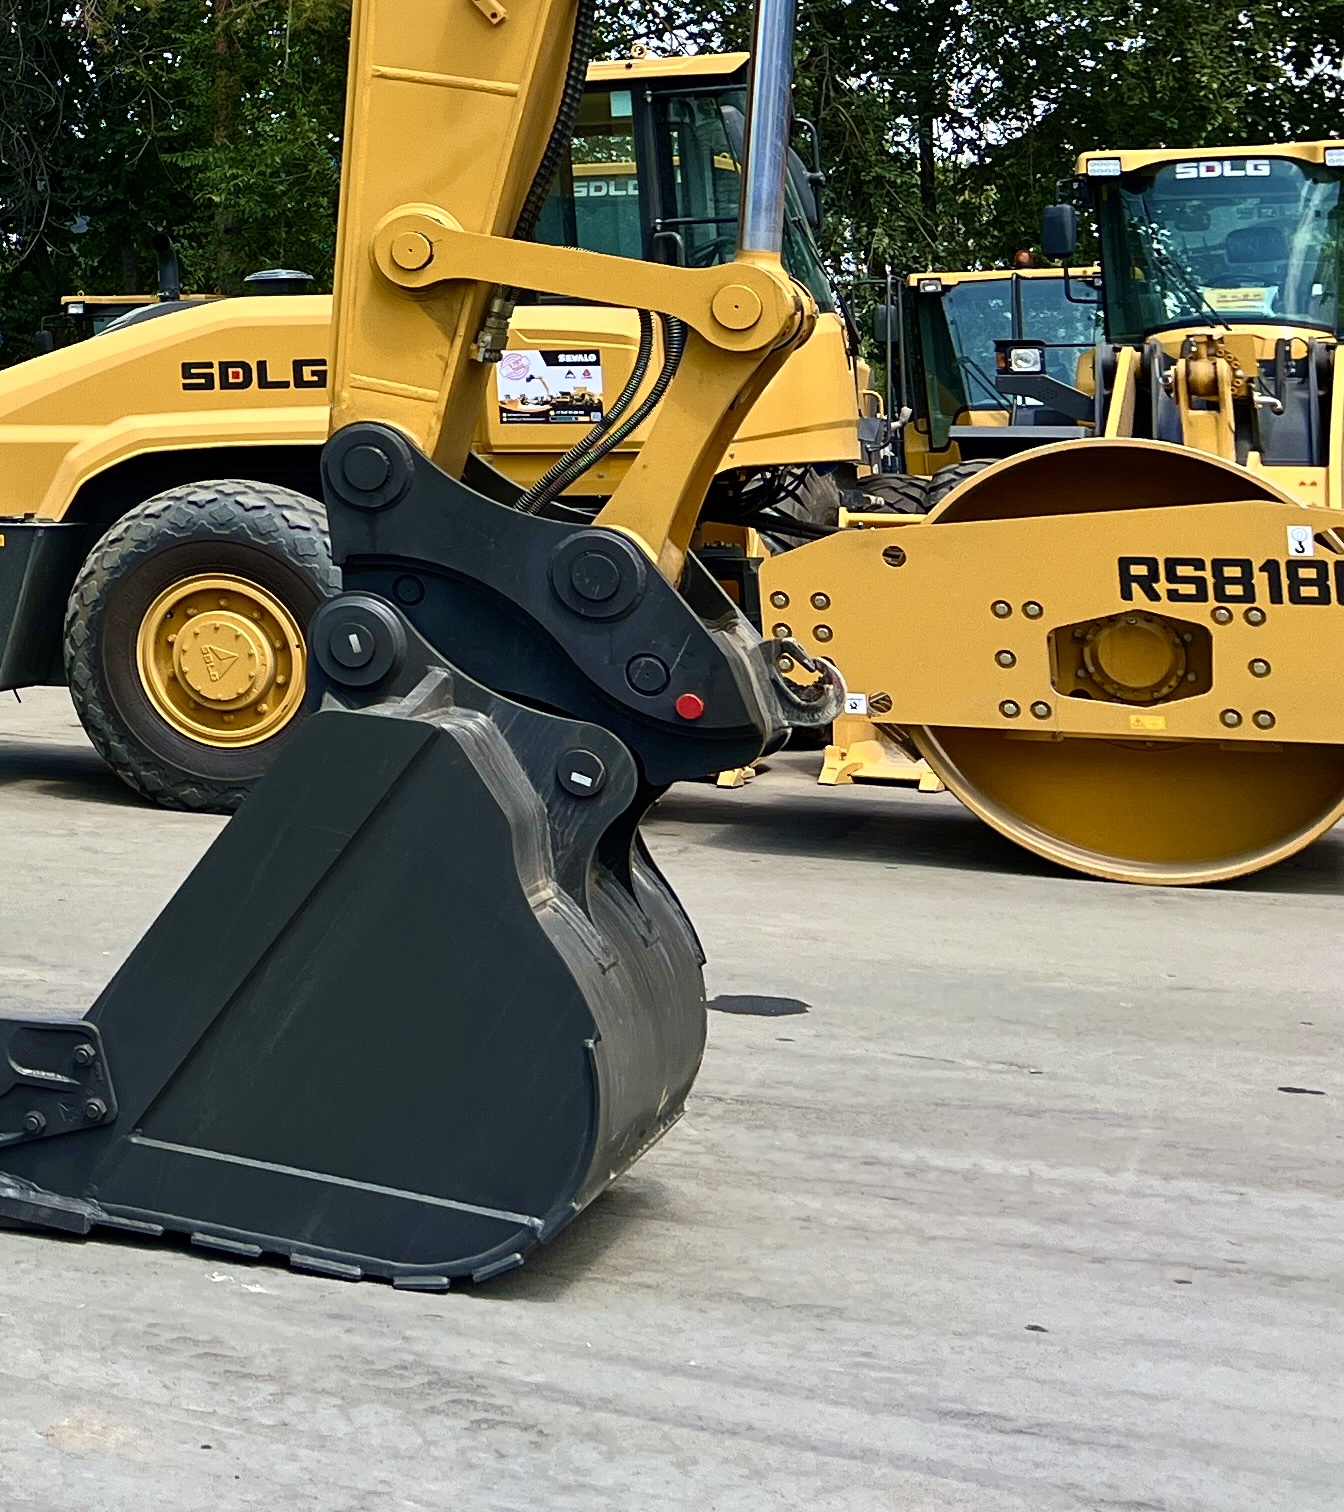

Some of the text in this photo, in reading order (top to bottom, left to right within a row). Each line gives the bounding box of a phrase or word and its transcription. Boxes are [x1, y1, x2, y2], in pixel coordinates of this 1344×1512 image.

[1175, 159, 1271, 179] SDLG
[181, 358, 329, 391] SDLG
[1118, 556, 1344, 606] RS818
